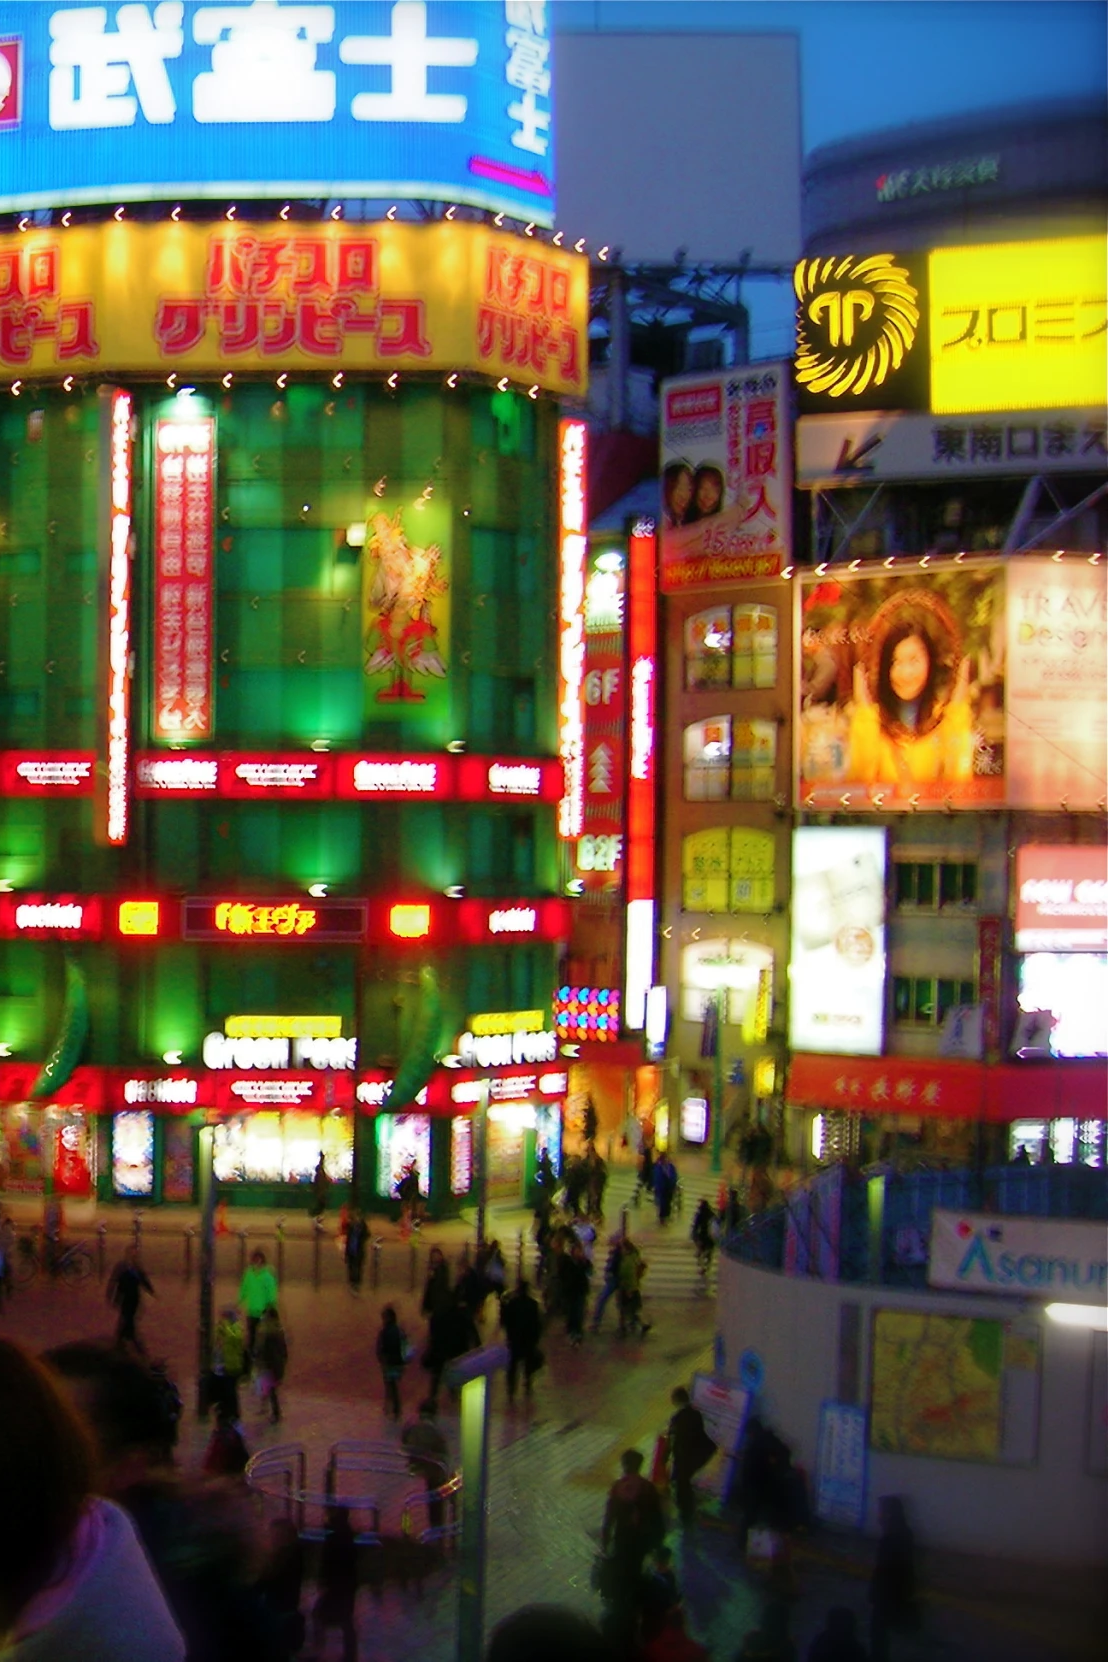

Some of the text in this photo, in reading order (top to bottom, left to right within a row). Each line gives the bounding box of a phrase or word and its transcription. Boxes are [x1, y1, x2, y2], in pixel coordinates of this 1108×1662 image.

[48, 0, 480, 131] 武富士
[505, 0, 552, 157] 武富士
[154, 295, 434, 361] グリンピース
[1019, 590, 1108, 622] TRAV
[956, 1233, 1108, 1290] Asanu
